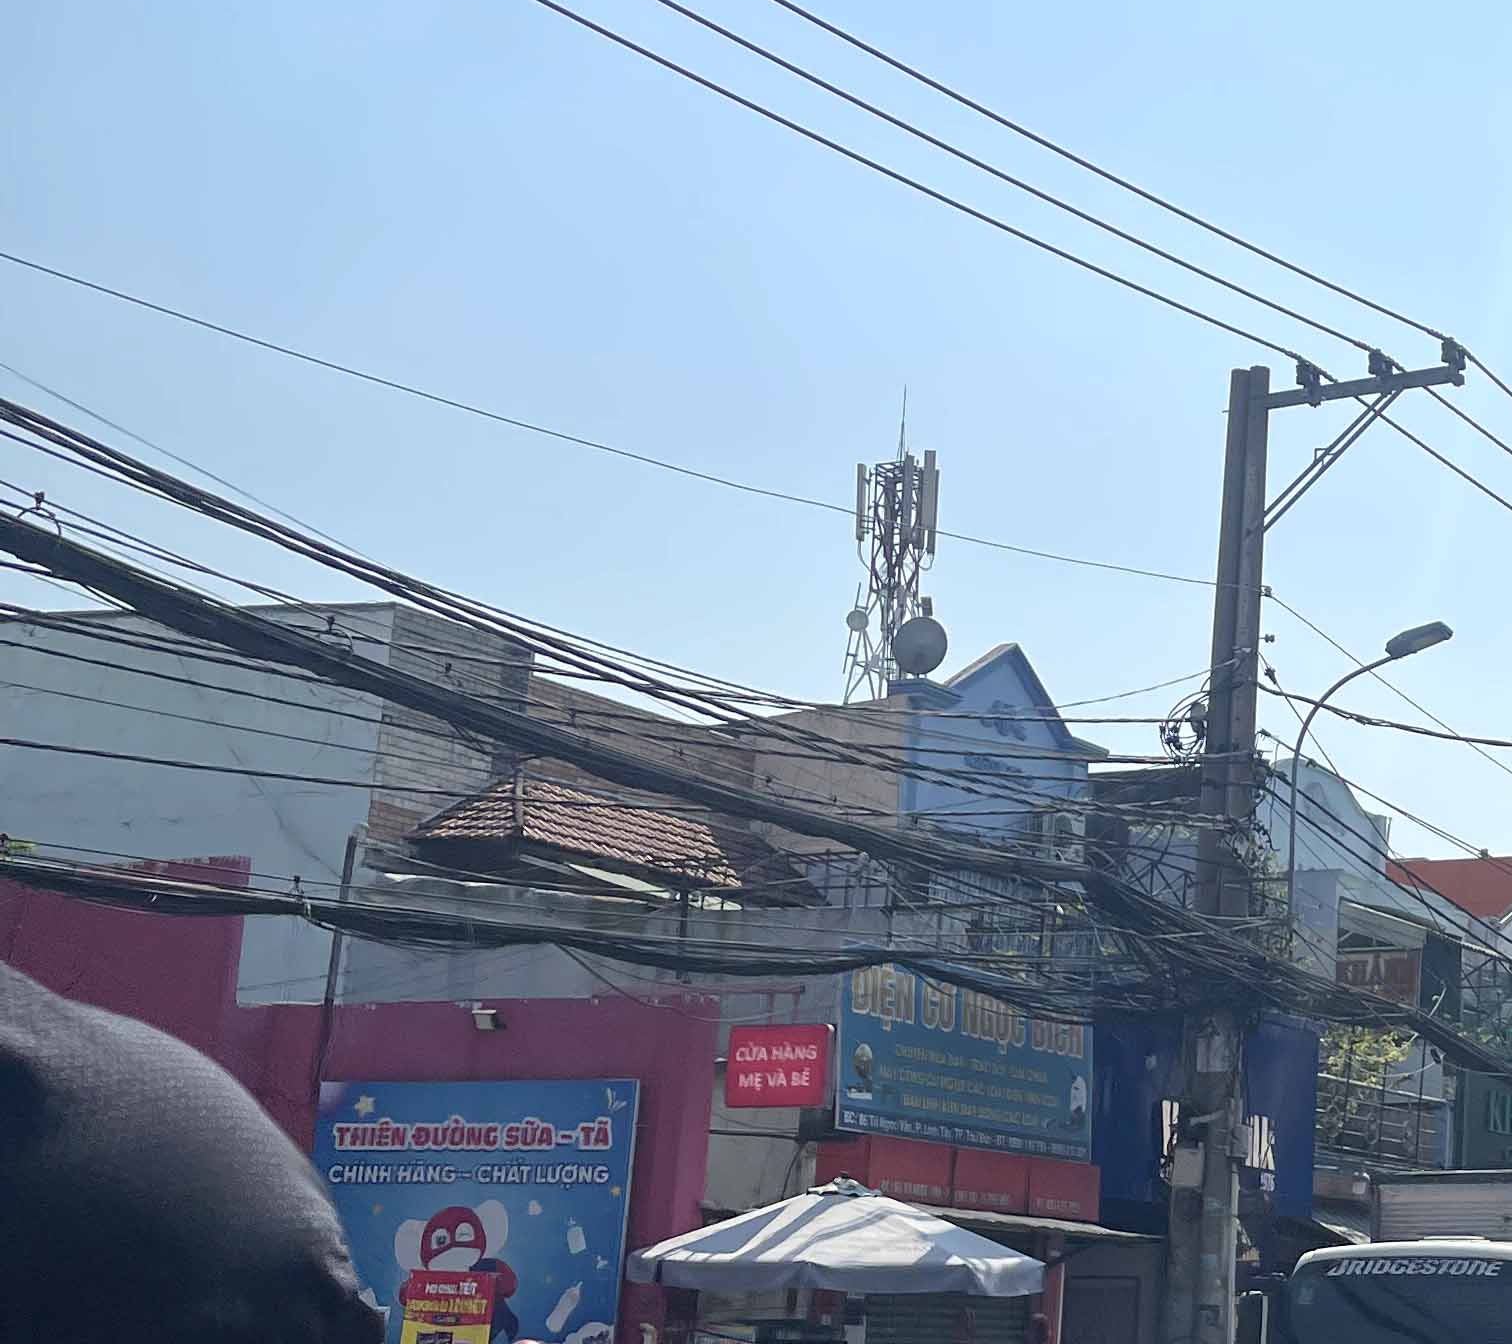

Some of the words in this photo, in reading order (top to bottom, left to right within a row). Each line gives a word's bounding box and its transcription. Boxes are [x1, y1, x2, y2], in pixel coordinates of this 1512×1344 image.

[771, 1041, 818, 1061] HÀNG
[738, 1071, 763, 1092] MẸ
[766, 1067, 787, 1088] VÀ
[333, 1117, 406, 1150] THIÊN
[410, 1114, 500, 1150] ĐƯỜNG
[504, 1117, 554, 1150] SỮA
[577, 1116, 613, 1150] TÃ
[534, 1162, 610, 1191] LƯỢNG
[1327, 1258, 1504, 1277] BRIDGESTONE
